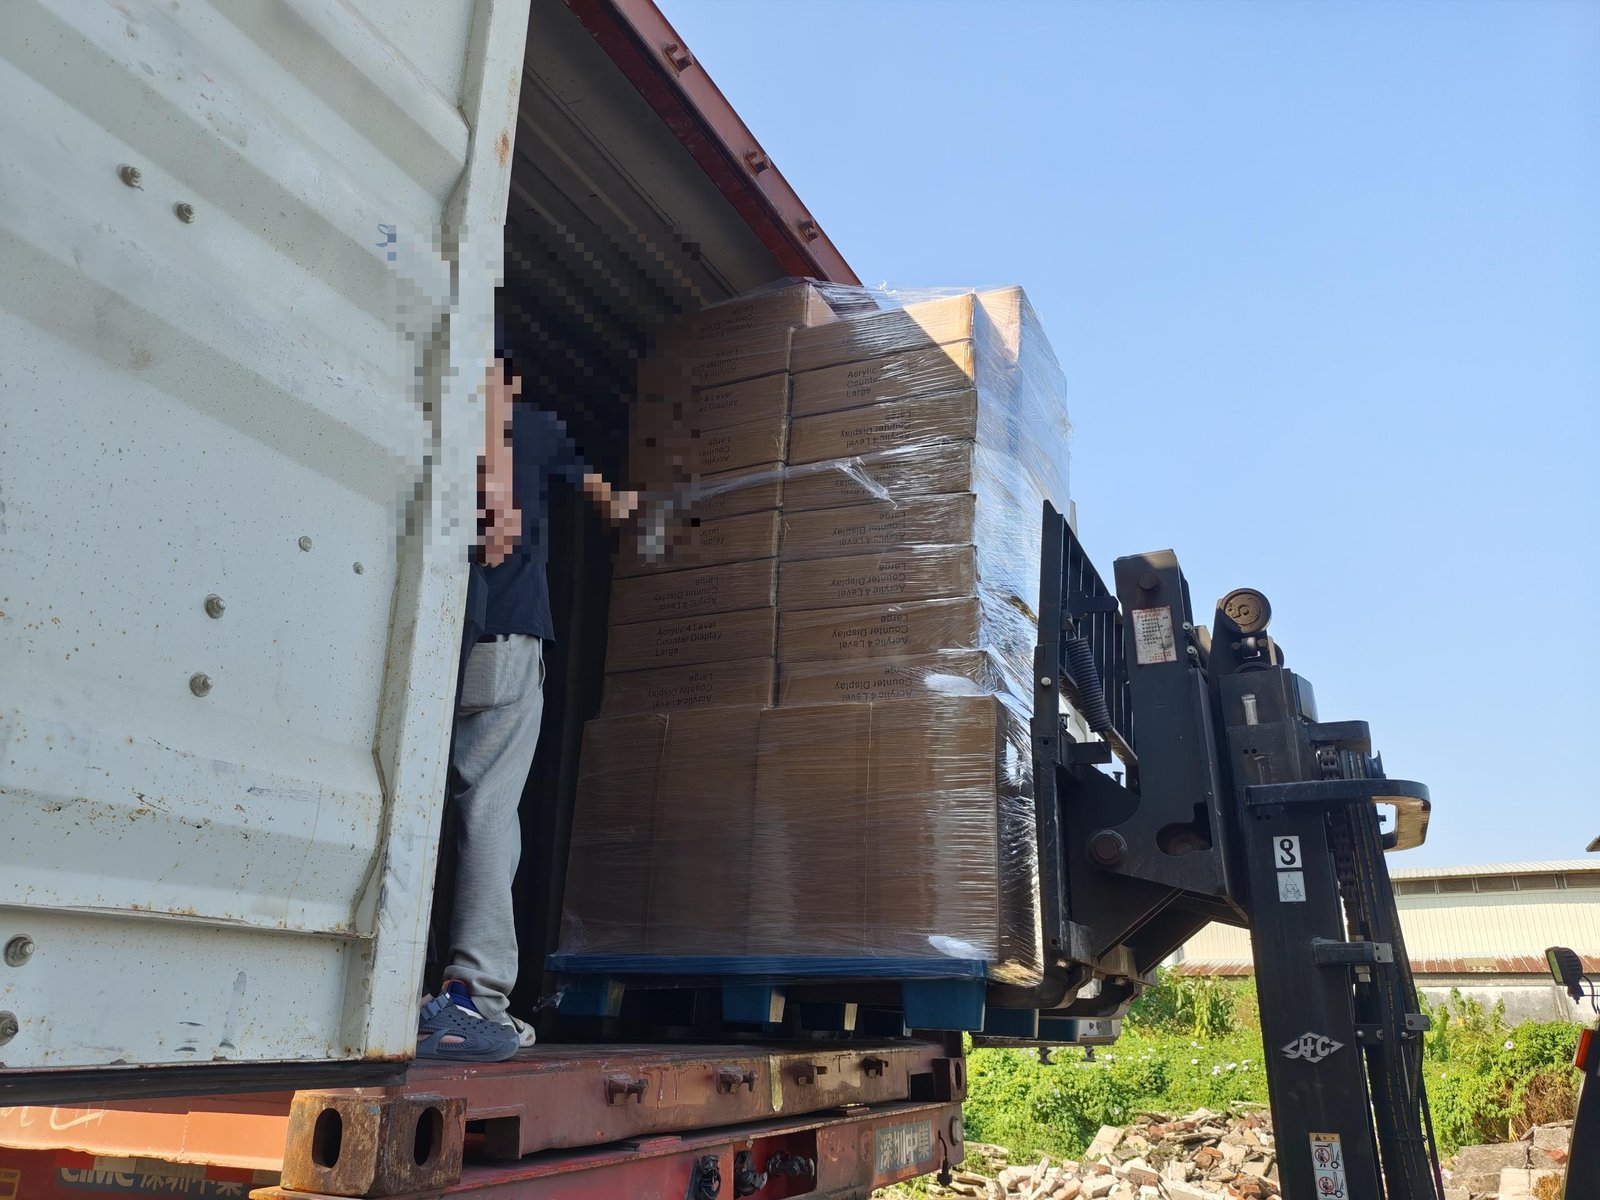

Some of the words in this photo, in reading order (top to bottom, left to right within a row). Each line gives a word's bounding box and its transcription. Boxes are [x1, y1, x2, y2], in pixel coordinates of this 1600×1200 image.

[846, 367, 877, 379] Acrylic
[846, 388, 872, 398] Large
[840, 428, 873, 438] Display
[846, 438, 871, 448] Level
[832, 526, 866, 536] Display
[831, 576, 865, 586] Display
[868, 573, 906, 582] Counter
[873, 583, 906, 593] Acrylic
[838, 588, 864, 599] Level
[656, 626, 684, 637] Acrylic
[692, 620, 717, 631] Level
[832, 629, 867, 638] Display
[869, 625, 909, 635] Counter
[656, 635, 688, 646] Counter
[690, 631, 723, 642] Display
[875, 636, 910, 646] Acrylic
[840, 641, 865, 650] Level
[655, 647, 679, 657] Large
[688, 672, 713, 682] Large
[680, 683, 713, 694] Counter
[834, 681, 871, 691] Display
[872, 679, 913, 689] Counter
[648, 687, 678, 698] Display
[842, 692, 868, 701] Level
[878, 688, 913, 699] Acrylic
[683, 694, 712, 705] Acrylic
[652, 700, 675, 710] Level
[880, 1125, 930, 1170] 深圳中集
